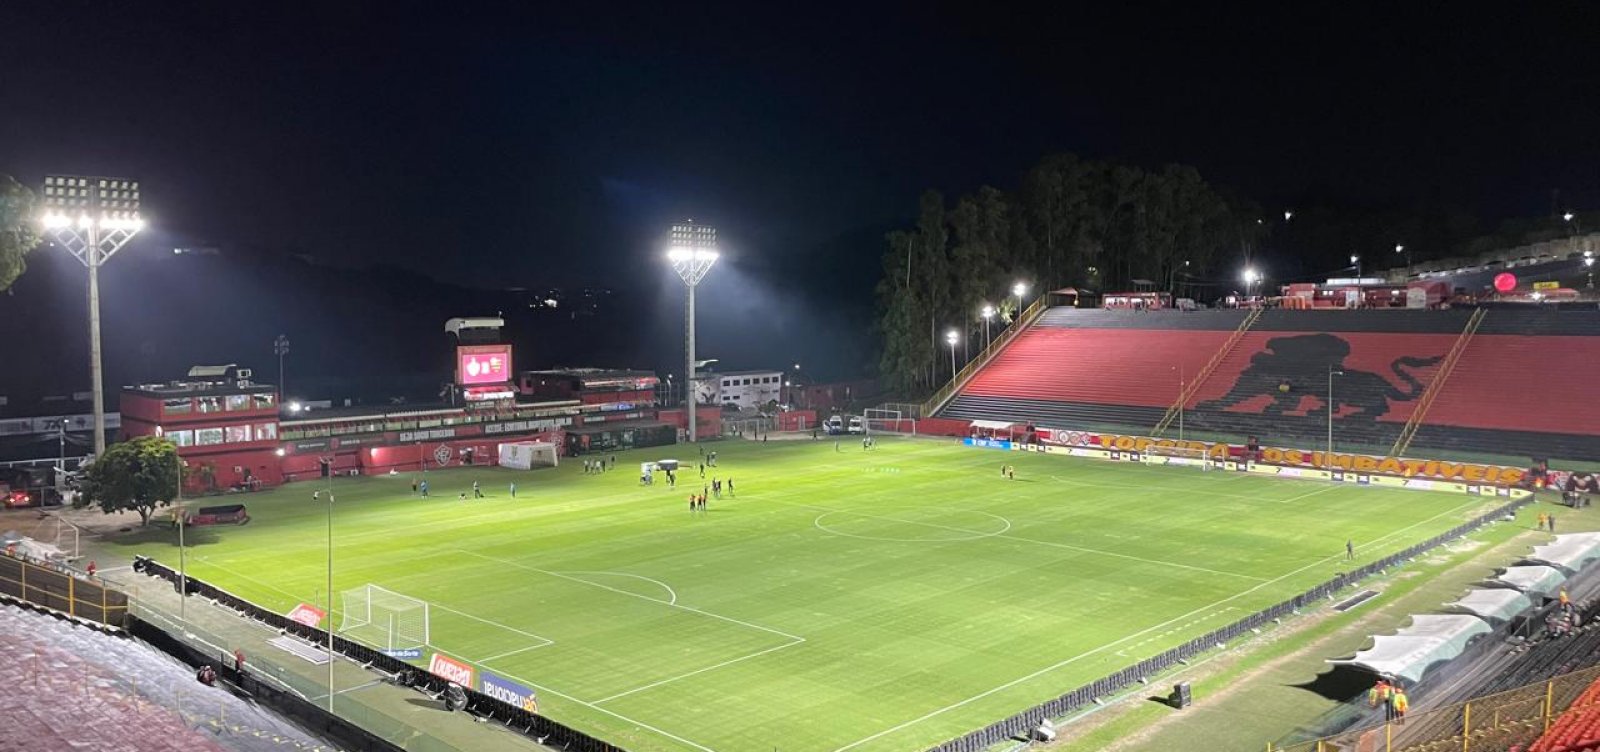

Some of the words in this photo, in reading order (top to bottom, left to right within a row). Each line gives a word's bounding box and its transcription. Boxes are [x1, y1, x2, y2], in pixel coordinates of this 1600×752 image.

[1098, 433, 1230, 458] TORCIDA
[1263, 447, 1304, 466] OS
[435, 659, 471, 688] betano
[484, 681, 538, 714] betnacional
